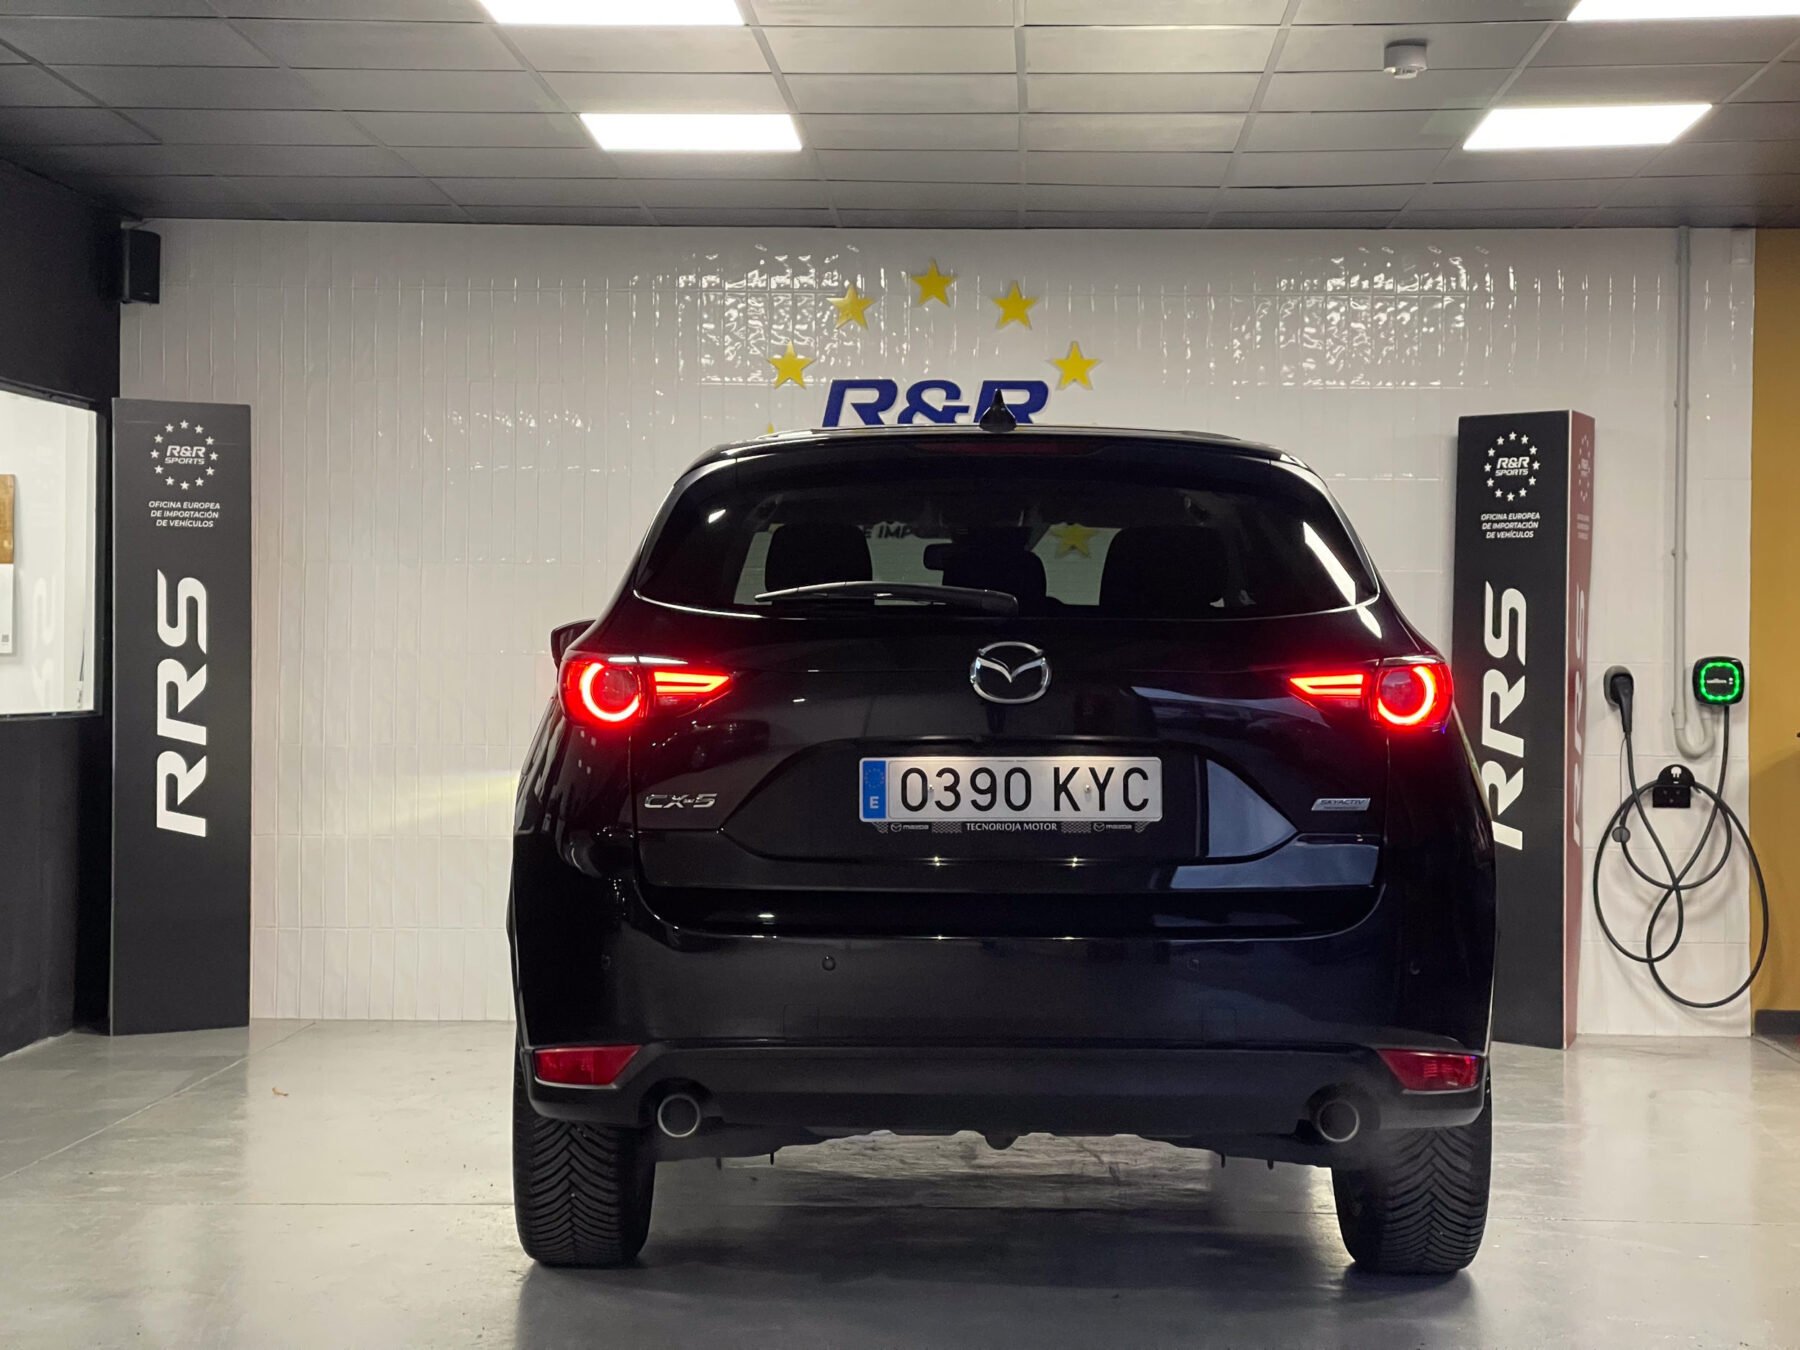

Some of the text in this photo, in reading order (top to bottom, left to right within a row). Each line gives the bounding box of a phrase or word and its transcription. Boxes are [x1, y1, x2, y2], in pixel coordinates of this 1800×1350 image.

[822, 379, 1049, 427] R&R
[166, 445, 206, 457] R&R
[164, 457, 205, 465] SPORTS
[1496, 456, 1530, 469] R&R
[1494, 468, 1529, 477] SPORTS
[163, 510, 219, 519] IMPORTACIÓN
[1481, 512, 1540, 521] OFICINA EUROPEA
[156, 519, 214, 528] DE VEHÍCULOS
[1482, 522, 1492, 530] DE
[1486, 529, 1534, 539] DE VEHÍCULOS
[156, 569, 207, 837] RRS
[1482, 580, 1527, 850] RRS
[901, 767, 1149, 812] 0390 KYC
[644, 793, 718, 808] CX-5
[869, 796, 879, 809] E
[966, 823, 1058, 832] TECNORIOJA MOTOR
